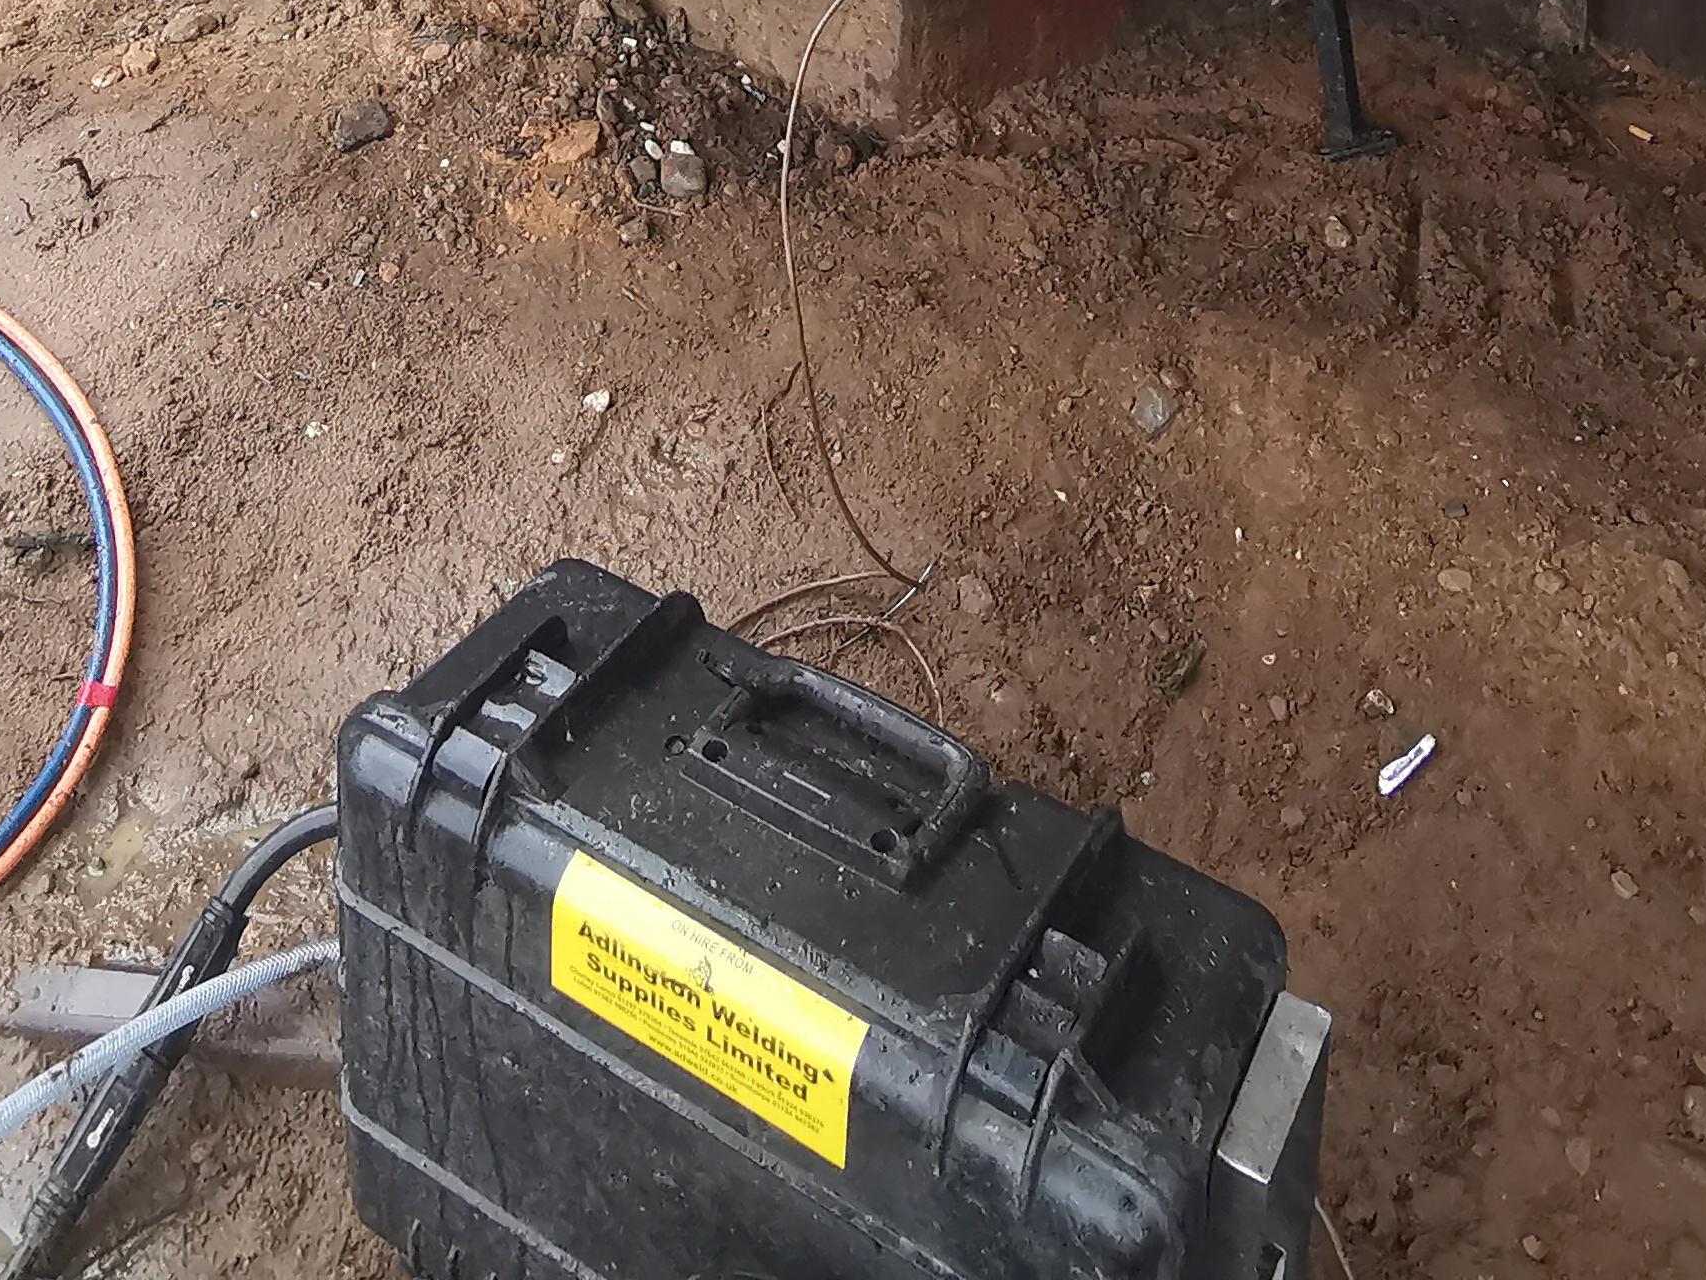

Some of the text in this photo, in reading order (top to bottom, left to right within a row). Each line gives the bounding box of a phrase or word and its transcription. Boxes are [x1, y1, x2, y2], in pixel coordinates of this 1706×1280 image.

[689, 929, 720, 954] HIRE
[719, 947, 755, 976] FROM
[586, 952, 697, 1032] Supplies
[706, 1024, 808, 1103] Limited
[711, 999, 819, 1085] Welding
